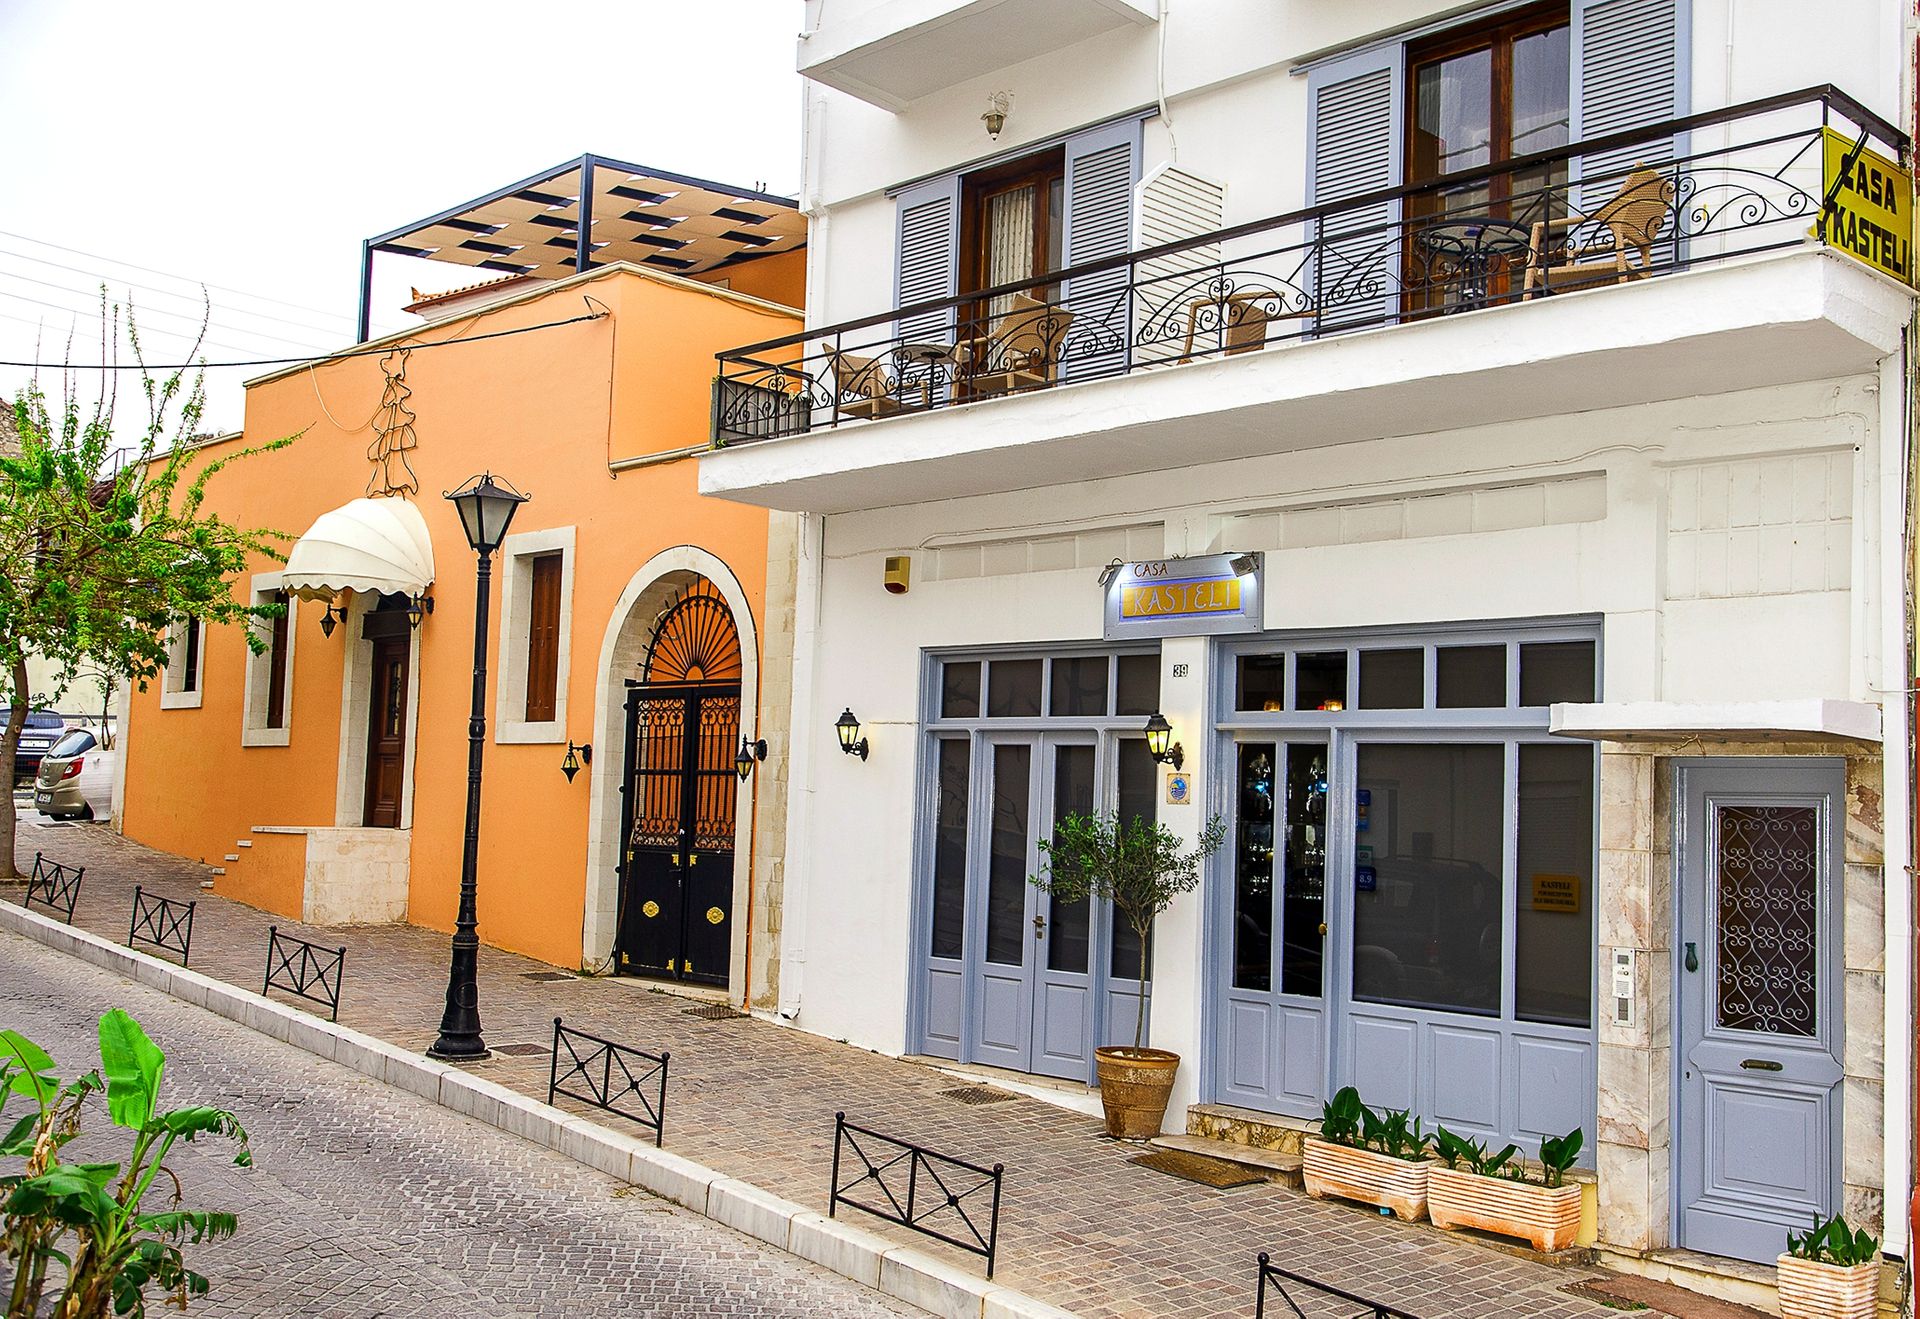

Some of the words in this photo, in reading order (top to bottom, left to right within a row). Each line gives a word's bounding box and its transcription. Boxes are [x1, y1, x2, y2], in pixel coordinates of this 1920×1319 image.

[1832, 203, 1907, 276] KASTELI
[1134, 563, 1168, 577] CASA
[1133, 583, 1230, 614] KASTELI
[1173, 664, 1188, 677] 39
